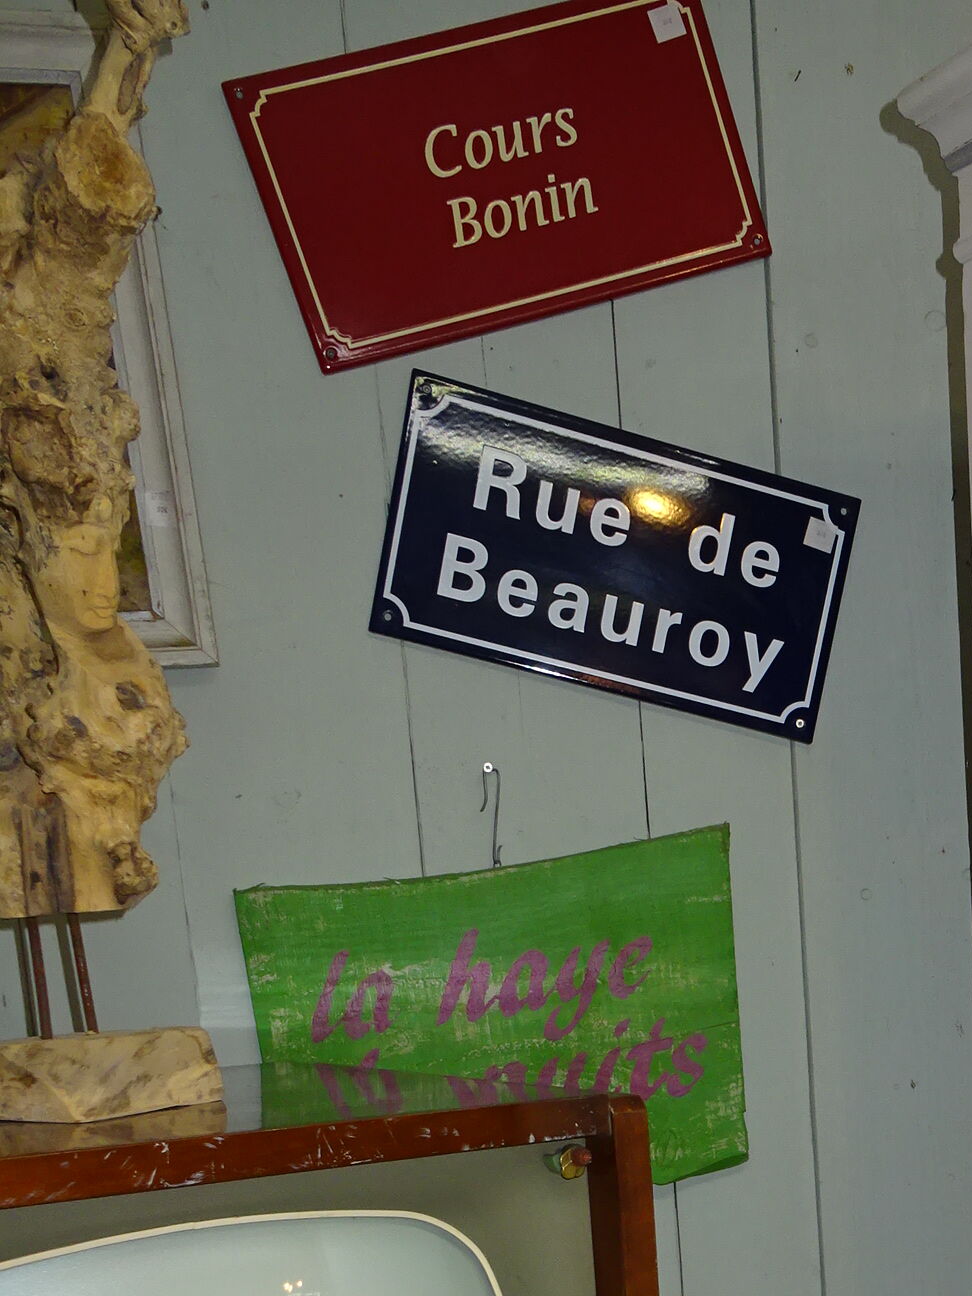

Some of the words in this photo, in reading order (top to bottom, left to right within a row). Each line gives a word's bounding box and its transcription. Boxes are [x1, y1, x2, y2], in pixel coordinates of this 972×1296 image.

[424, 106, 579, 179] Cours
[446, 173, 599, 249] Bonin
[472, 444, 632, 547] Rue
[687, 512, 781, 588] de
[436, 532, 785, 693] Beauroy
[311, 949, 394, 1044] la
[435, 927, 654, 1042] haye
